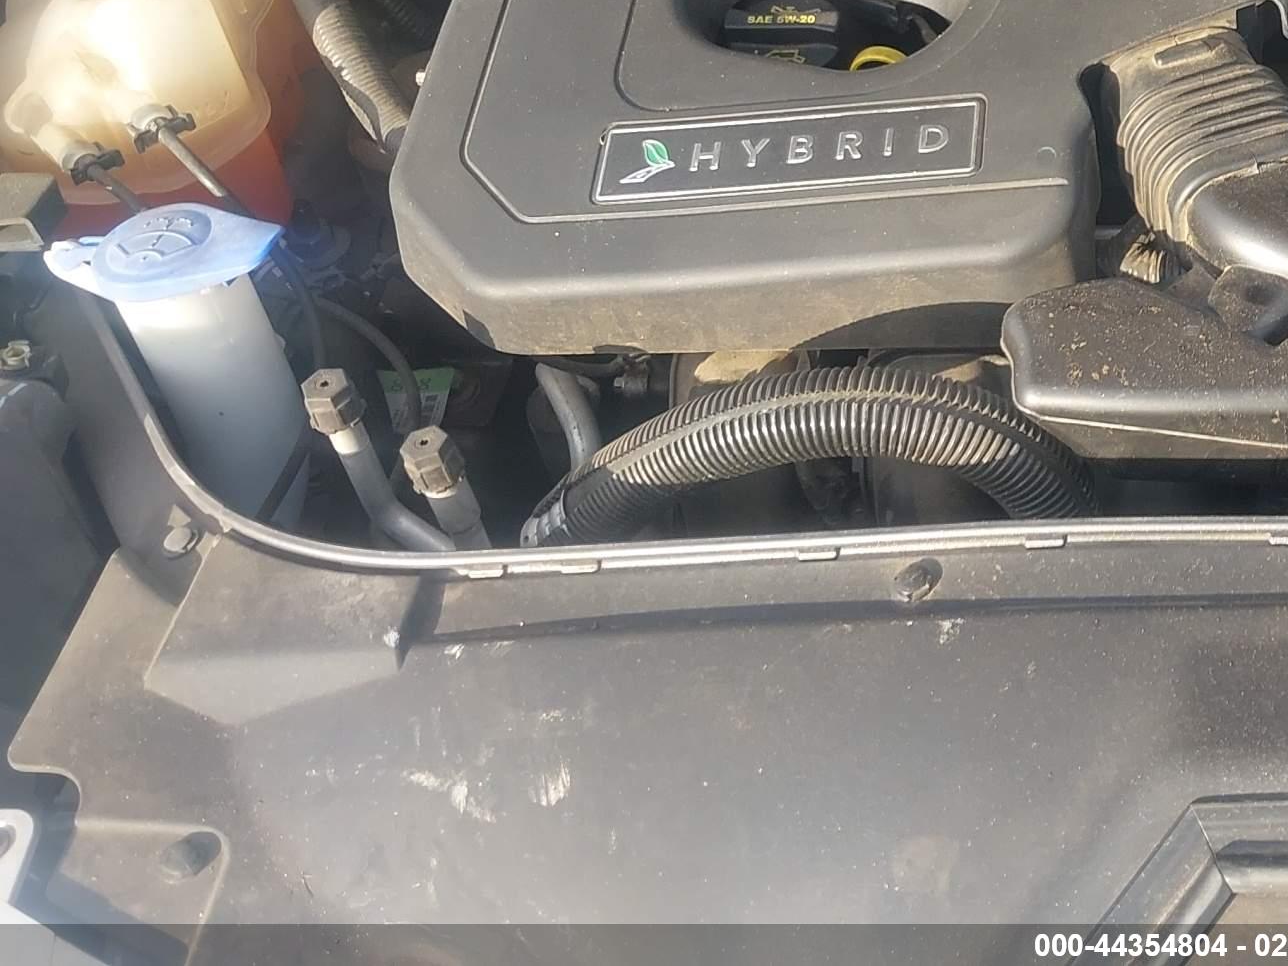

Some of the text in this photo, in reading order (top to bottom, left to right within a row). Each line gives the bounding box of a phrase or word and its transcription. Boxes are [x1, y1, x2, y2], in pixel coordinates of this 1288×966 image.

[747, 15, 816, 24] SAE 5W-20
[689, 125, 949, 171] HYBRID
